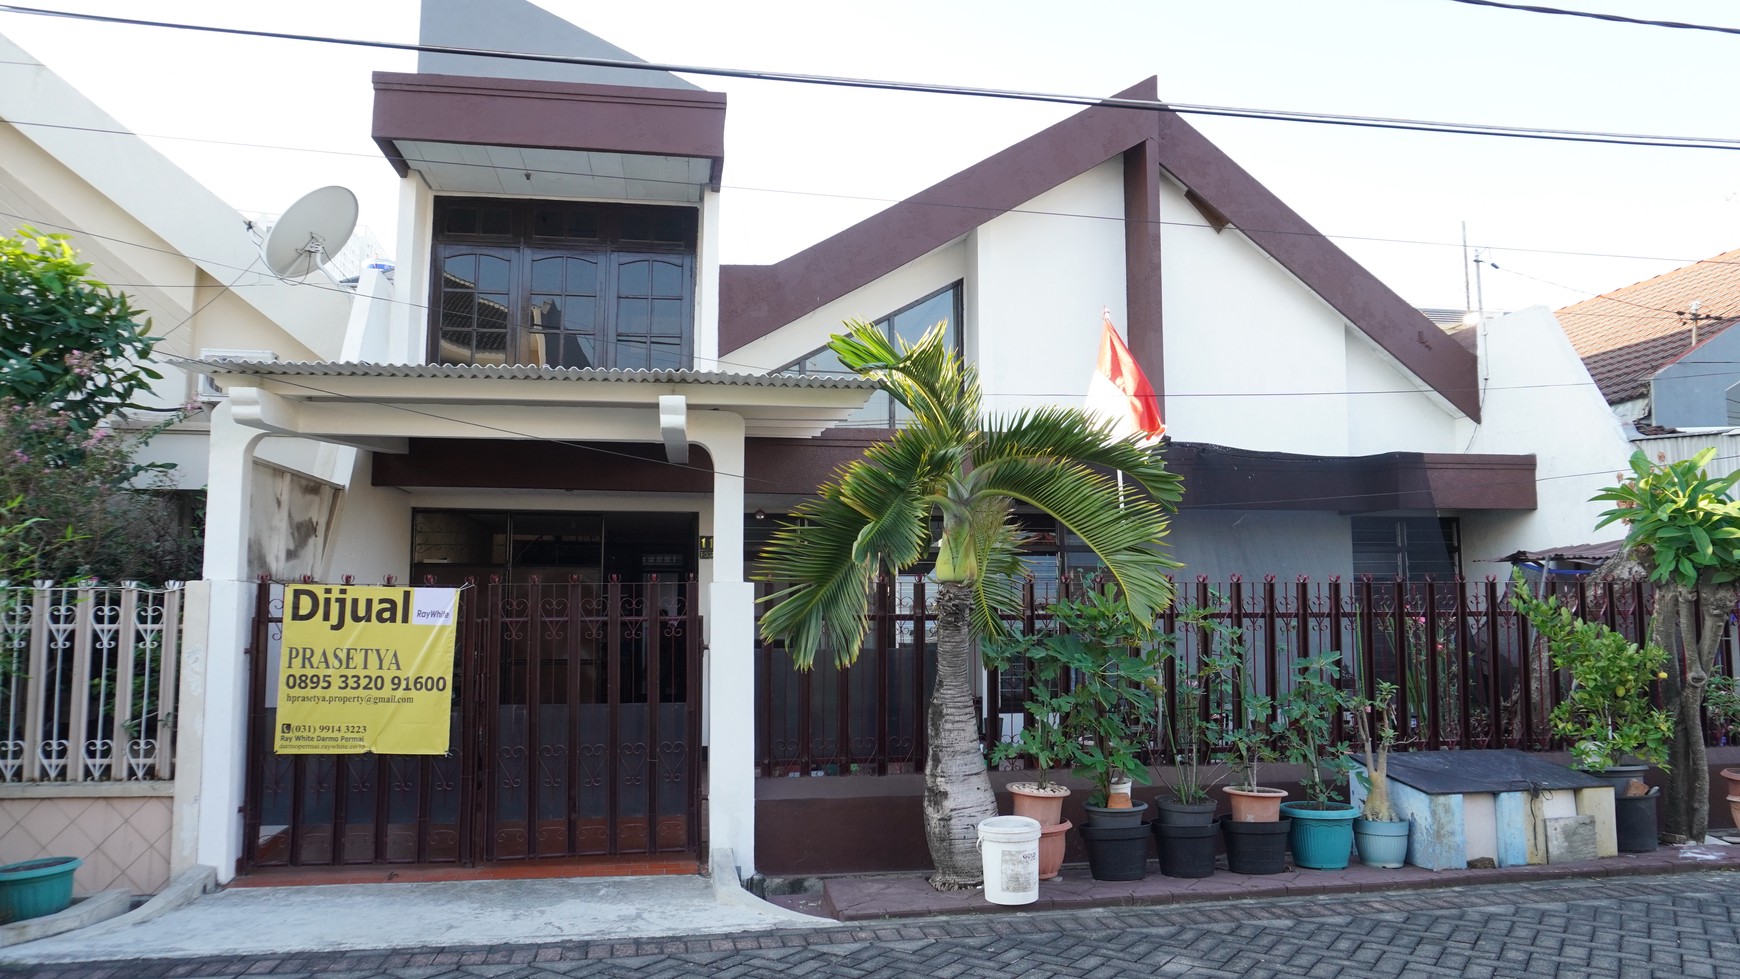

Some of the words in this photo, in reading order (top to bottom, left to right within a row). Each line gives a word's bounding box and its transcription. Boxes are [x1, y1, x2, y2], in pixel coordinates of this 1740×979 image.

[291, 588, 412, 631] Dijual
[287, 647, 402, 671] PRASETYA
[285, 674, 332, 690] 0895
[338, 674, 385, 691] 3320
[391, 676, 447, 692] 91600
[286, 693, 414, 705] hprasetya.property@gmail.com
[291, 724, 316, 735] (031)
[319, 725, 341, 734] 9914
[344, 725, 367, 734] 3223
[280, 735, 293, 743] Ray
